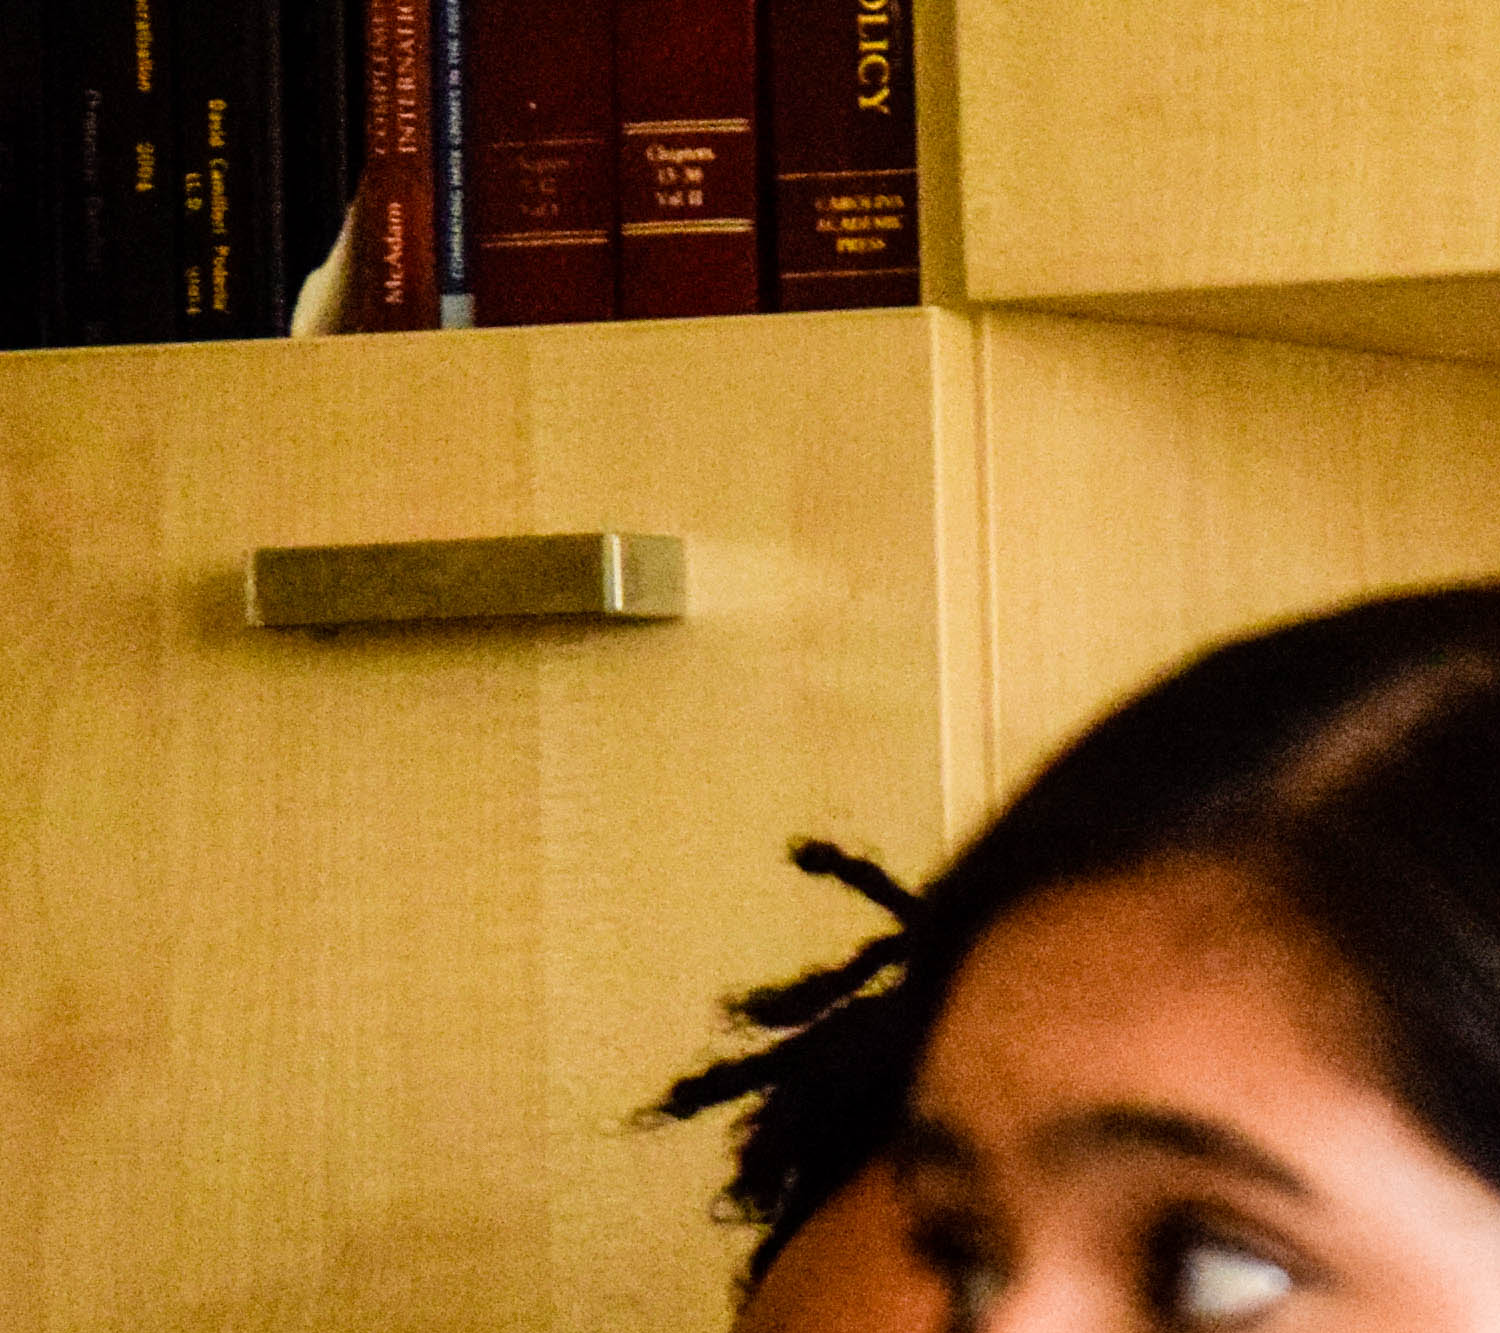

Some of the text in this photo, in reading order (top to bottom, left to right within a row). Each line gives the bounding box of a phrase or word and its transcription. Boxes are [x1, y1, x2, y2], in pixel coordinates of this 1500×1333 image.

[208, 99, 228, 148] David
[384, 202, 402, 303] McAdam
[835, 237, 887, 254] PRESS
